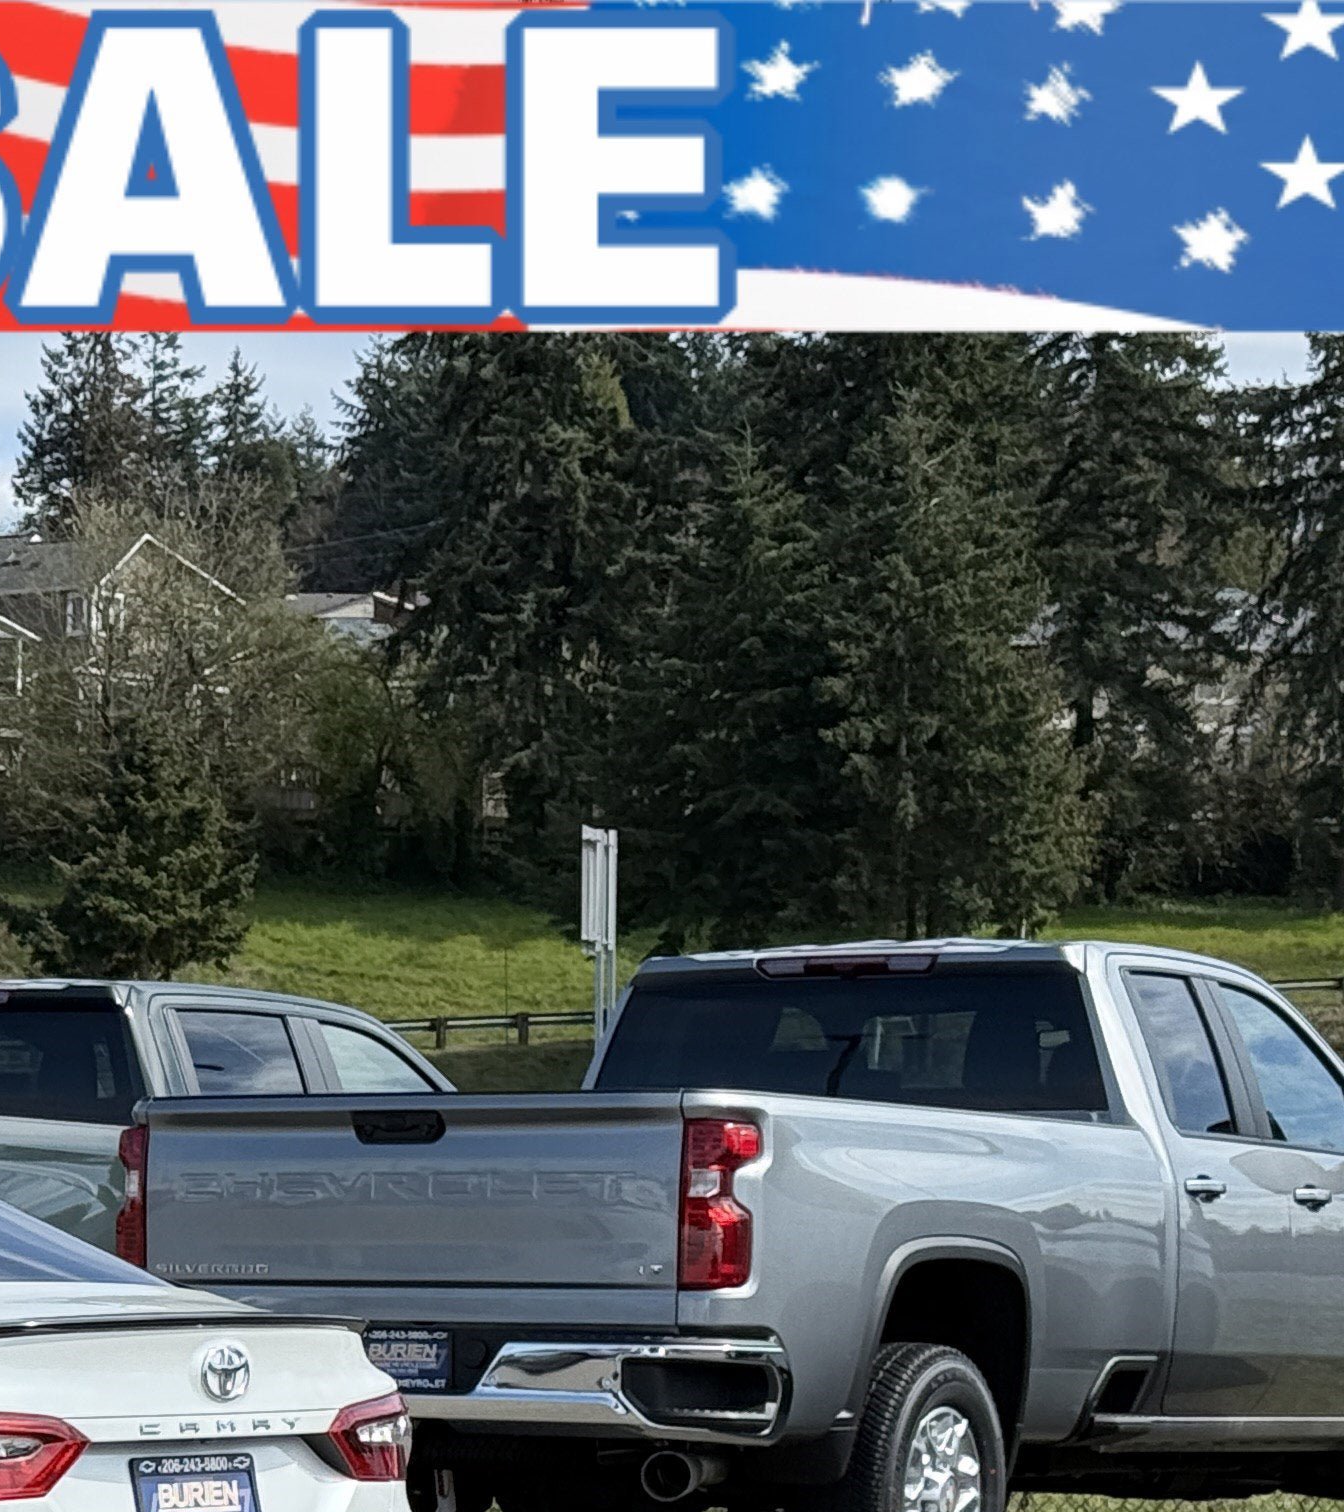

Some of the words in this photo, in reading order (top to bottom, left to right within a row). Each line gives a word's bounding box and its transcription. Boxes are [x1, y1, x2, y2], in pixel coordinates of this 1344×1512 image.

[180, 1171, 636, 1201] CHEVROLET
[368, 1343, 438, 1360] BURIEN
[139, 1416, 301, 1437] CAMRY
[158, 1480, 239, 1508] BURIEN
